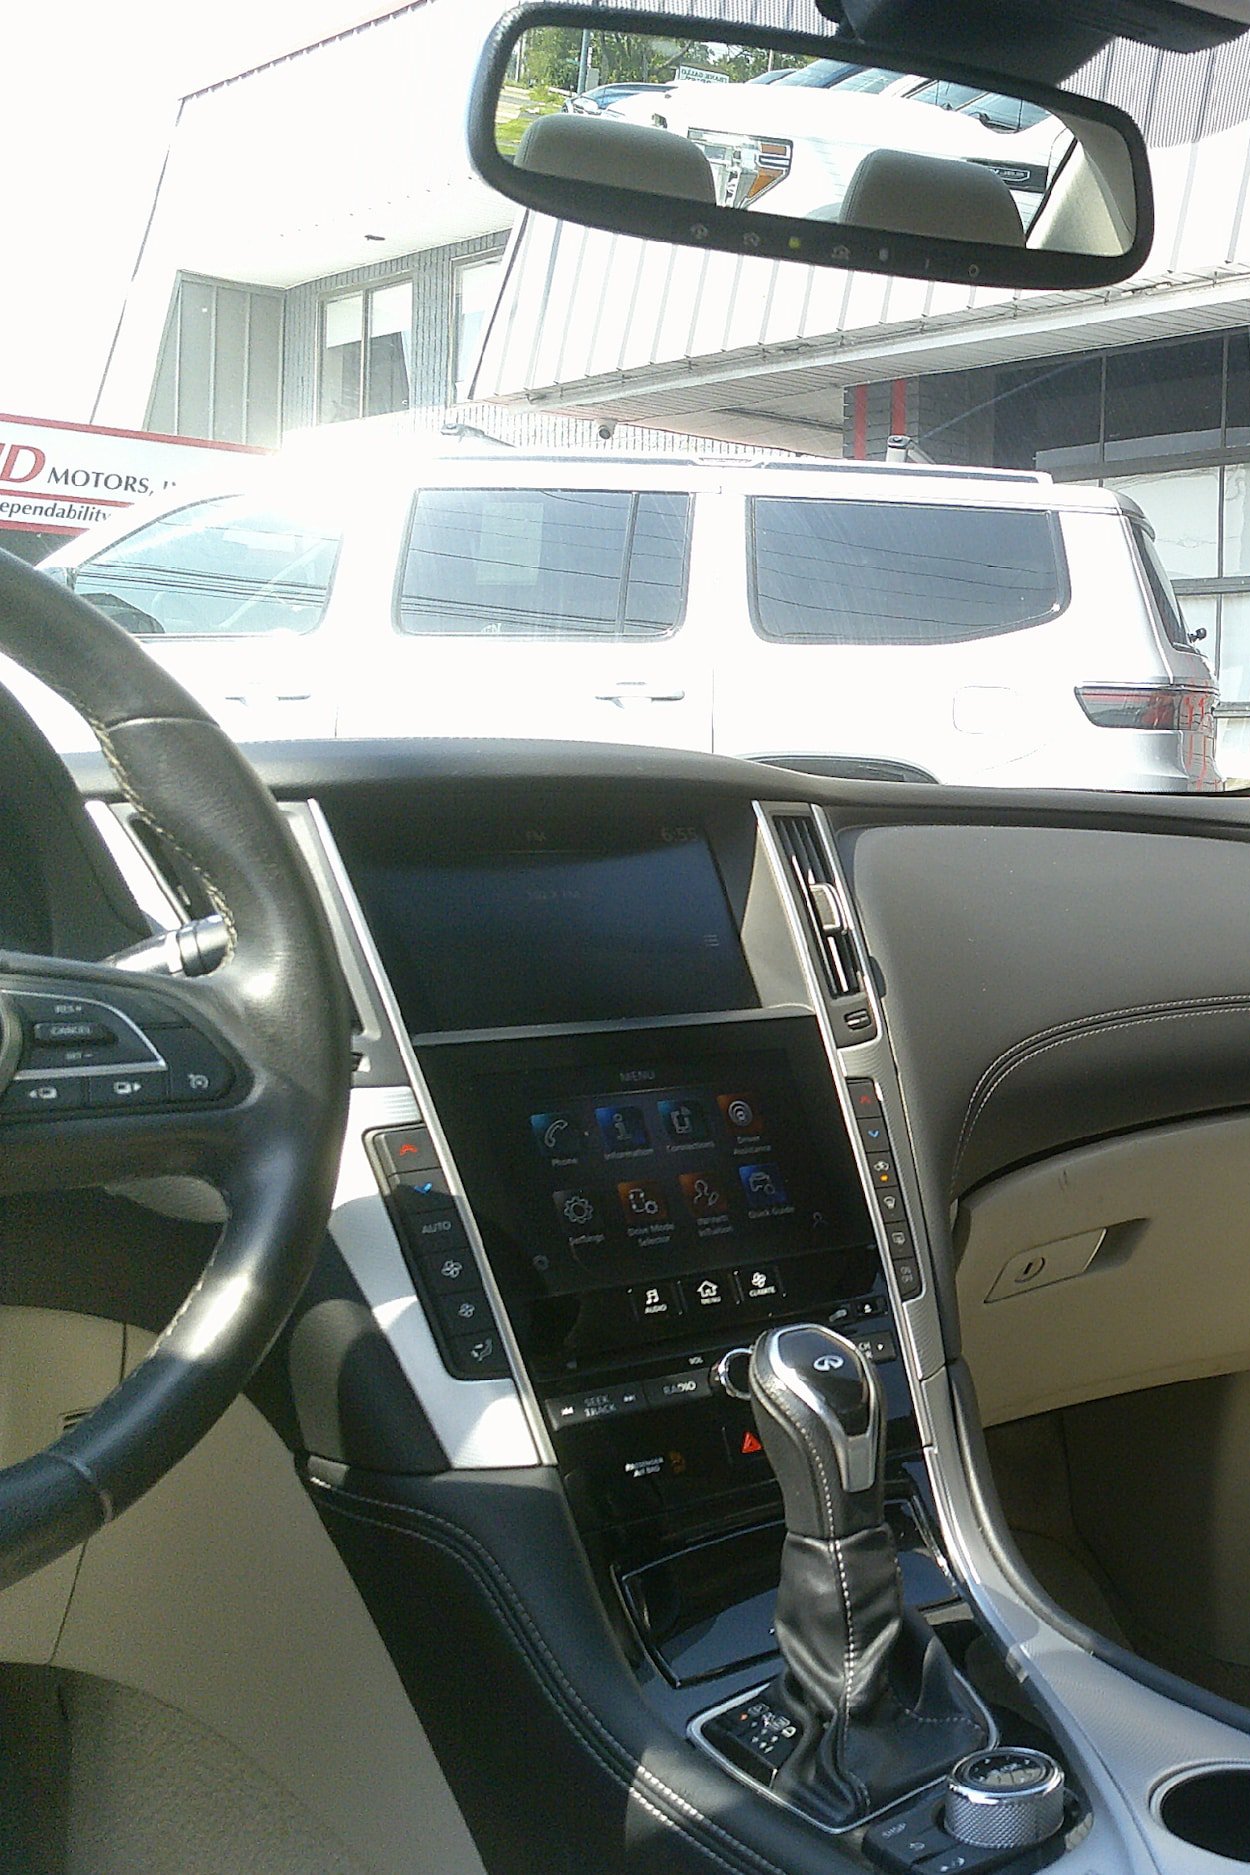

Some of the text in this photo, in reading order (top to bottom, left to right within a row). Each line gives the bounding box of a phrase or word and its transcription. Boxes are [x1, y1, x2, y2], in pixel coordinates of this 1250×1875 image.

[47, 467, 155, 497] MOTORS,
[50, 1024, 91, 1037] CANCEL
[618, 1069, 656, 1083] MENU
[421, 1220, 452, 1235] AUTO
[644, 1304, 668, 1315] AUDIO
[662, 1380, 697, 1396] RADIO
[584, 1403, 617, 1418] TRACK
